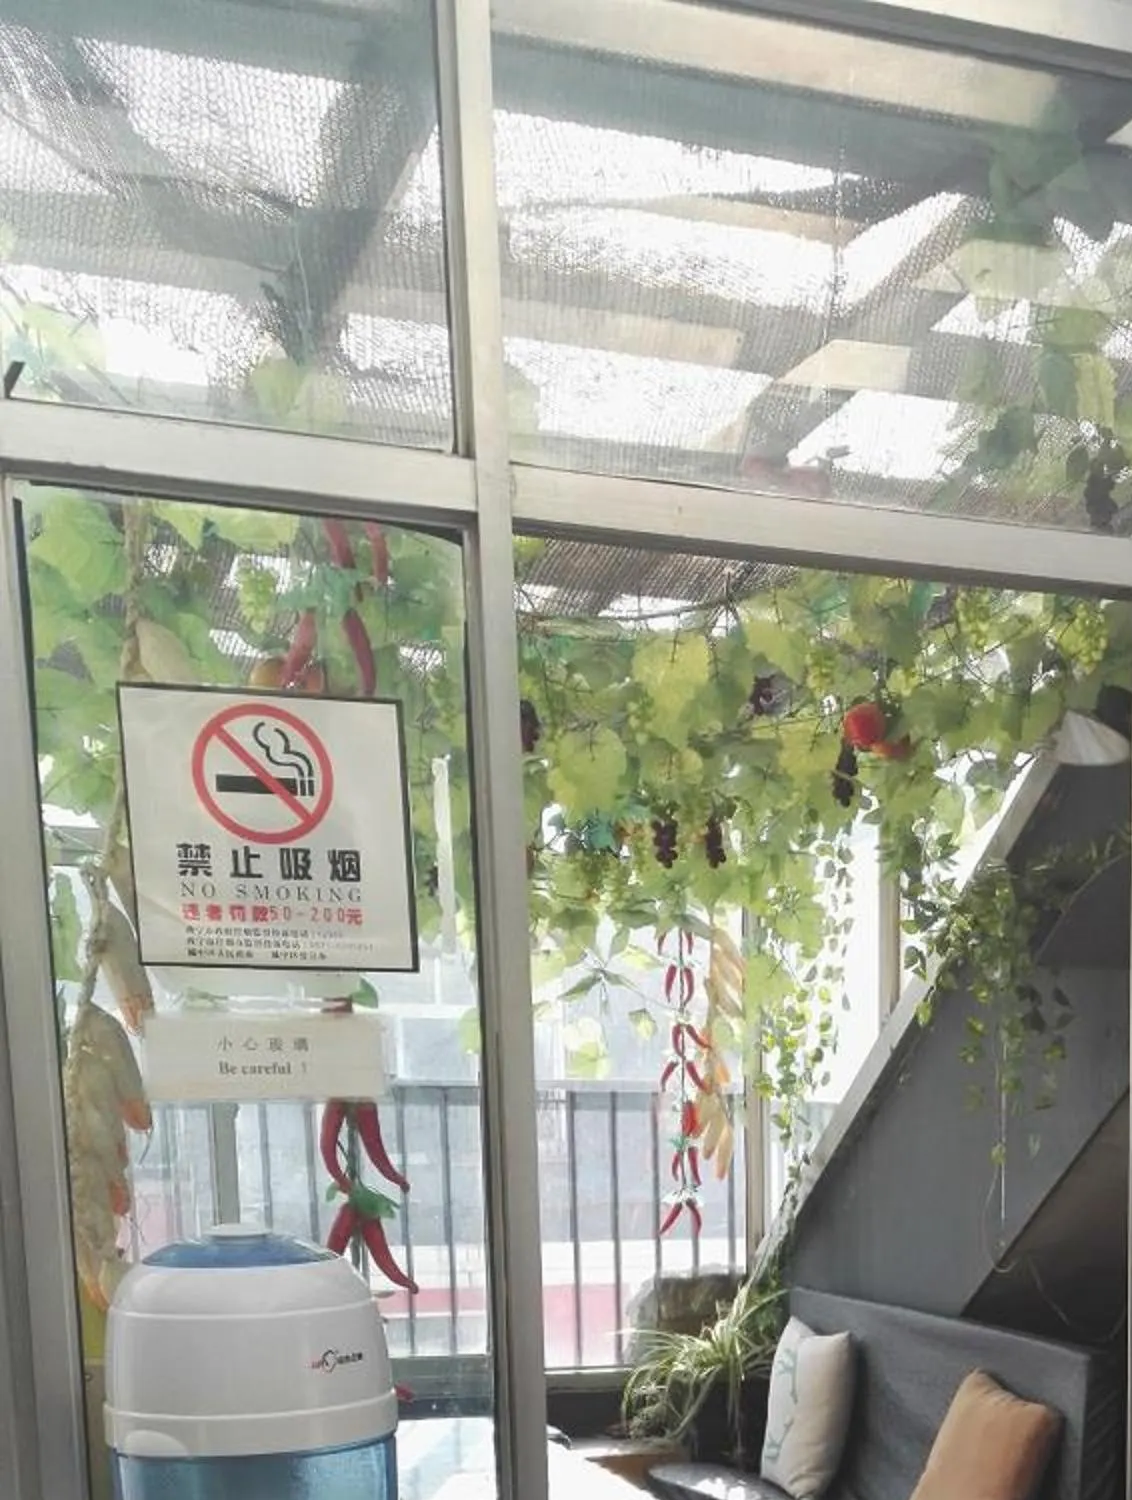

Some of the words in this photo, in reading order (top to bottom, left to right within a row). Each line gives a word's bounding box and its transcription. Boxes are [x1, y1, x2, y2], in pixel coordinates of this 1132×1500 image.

[176, 843, 361, 883] 禁止吸烟
[180, 881, 215, 898] NO
[235, 883, 361, 902] SMOKING
[219, 1060, 237, 1075] Be
[241, 1061, 291, 1075] careful
